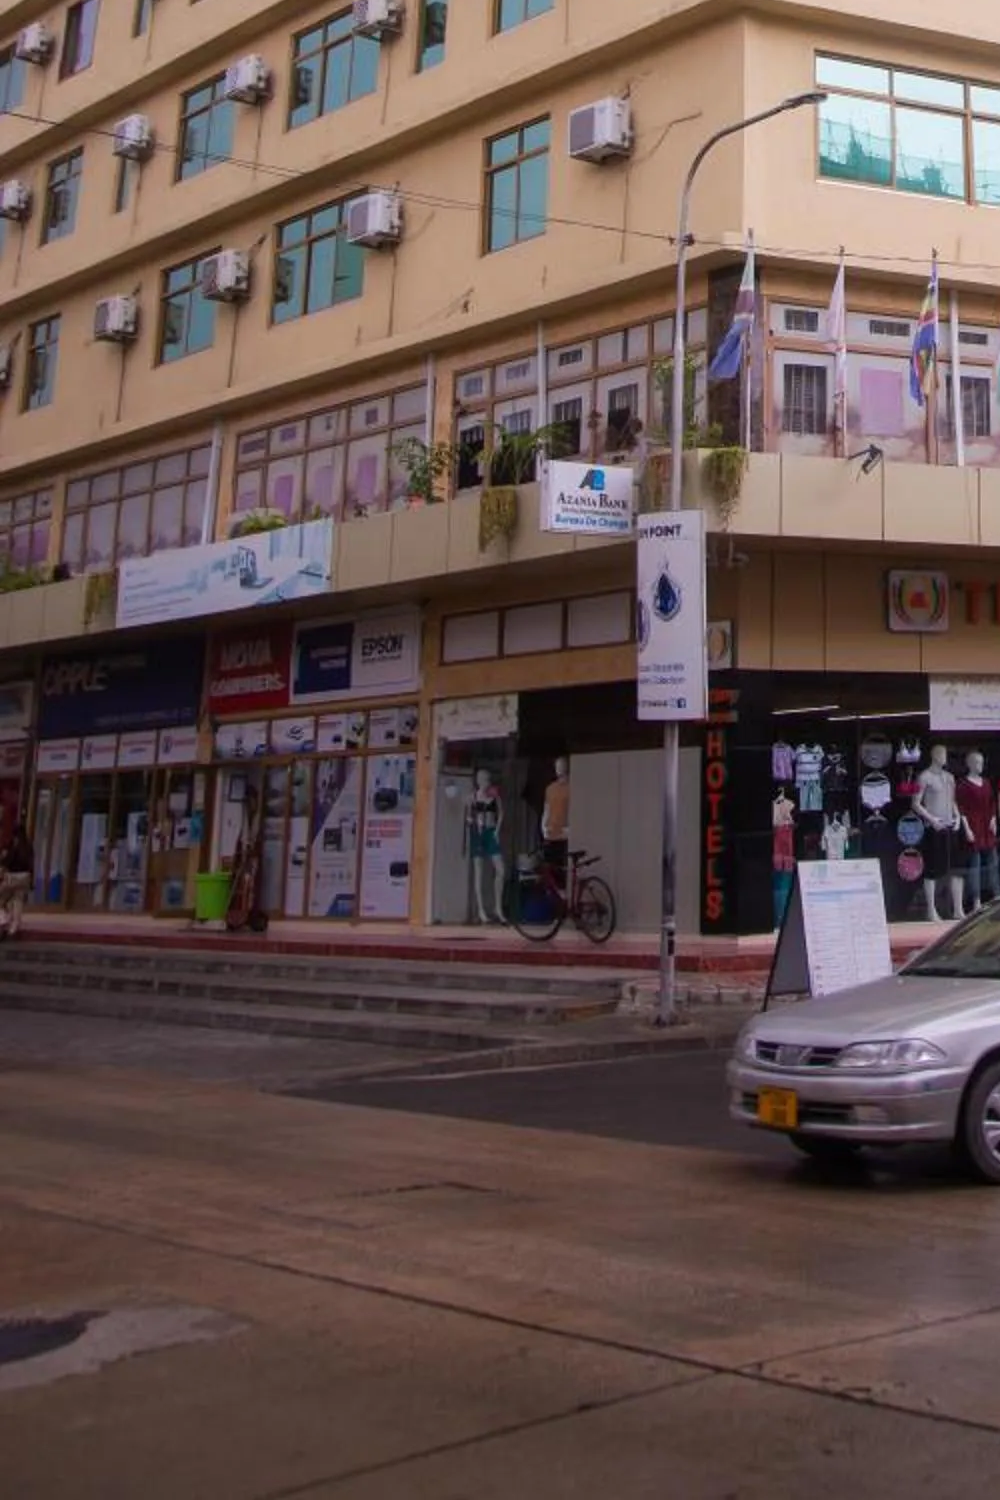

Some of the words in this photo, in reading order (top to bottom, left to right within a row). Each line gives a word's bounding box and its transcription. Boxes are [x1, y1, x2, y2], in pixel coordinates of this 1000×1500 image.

[649, 523, 682, 539] POINT
[361, 634, 404, 657] EPSON
[705, 731, 727, 921] HOTELS
